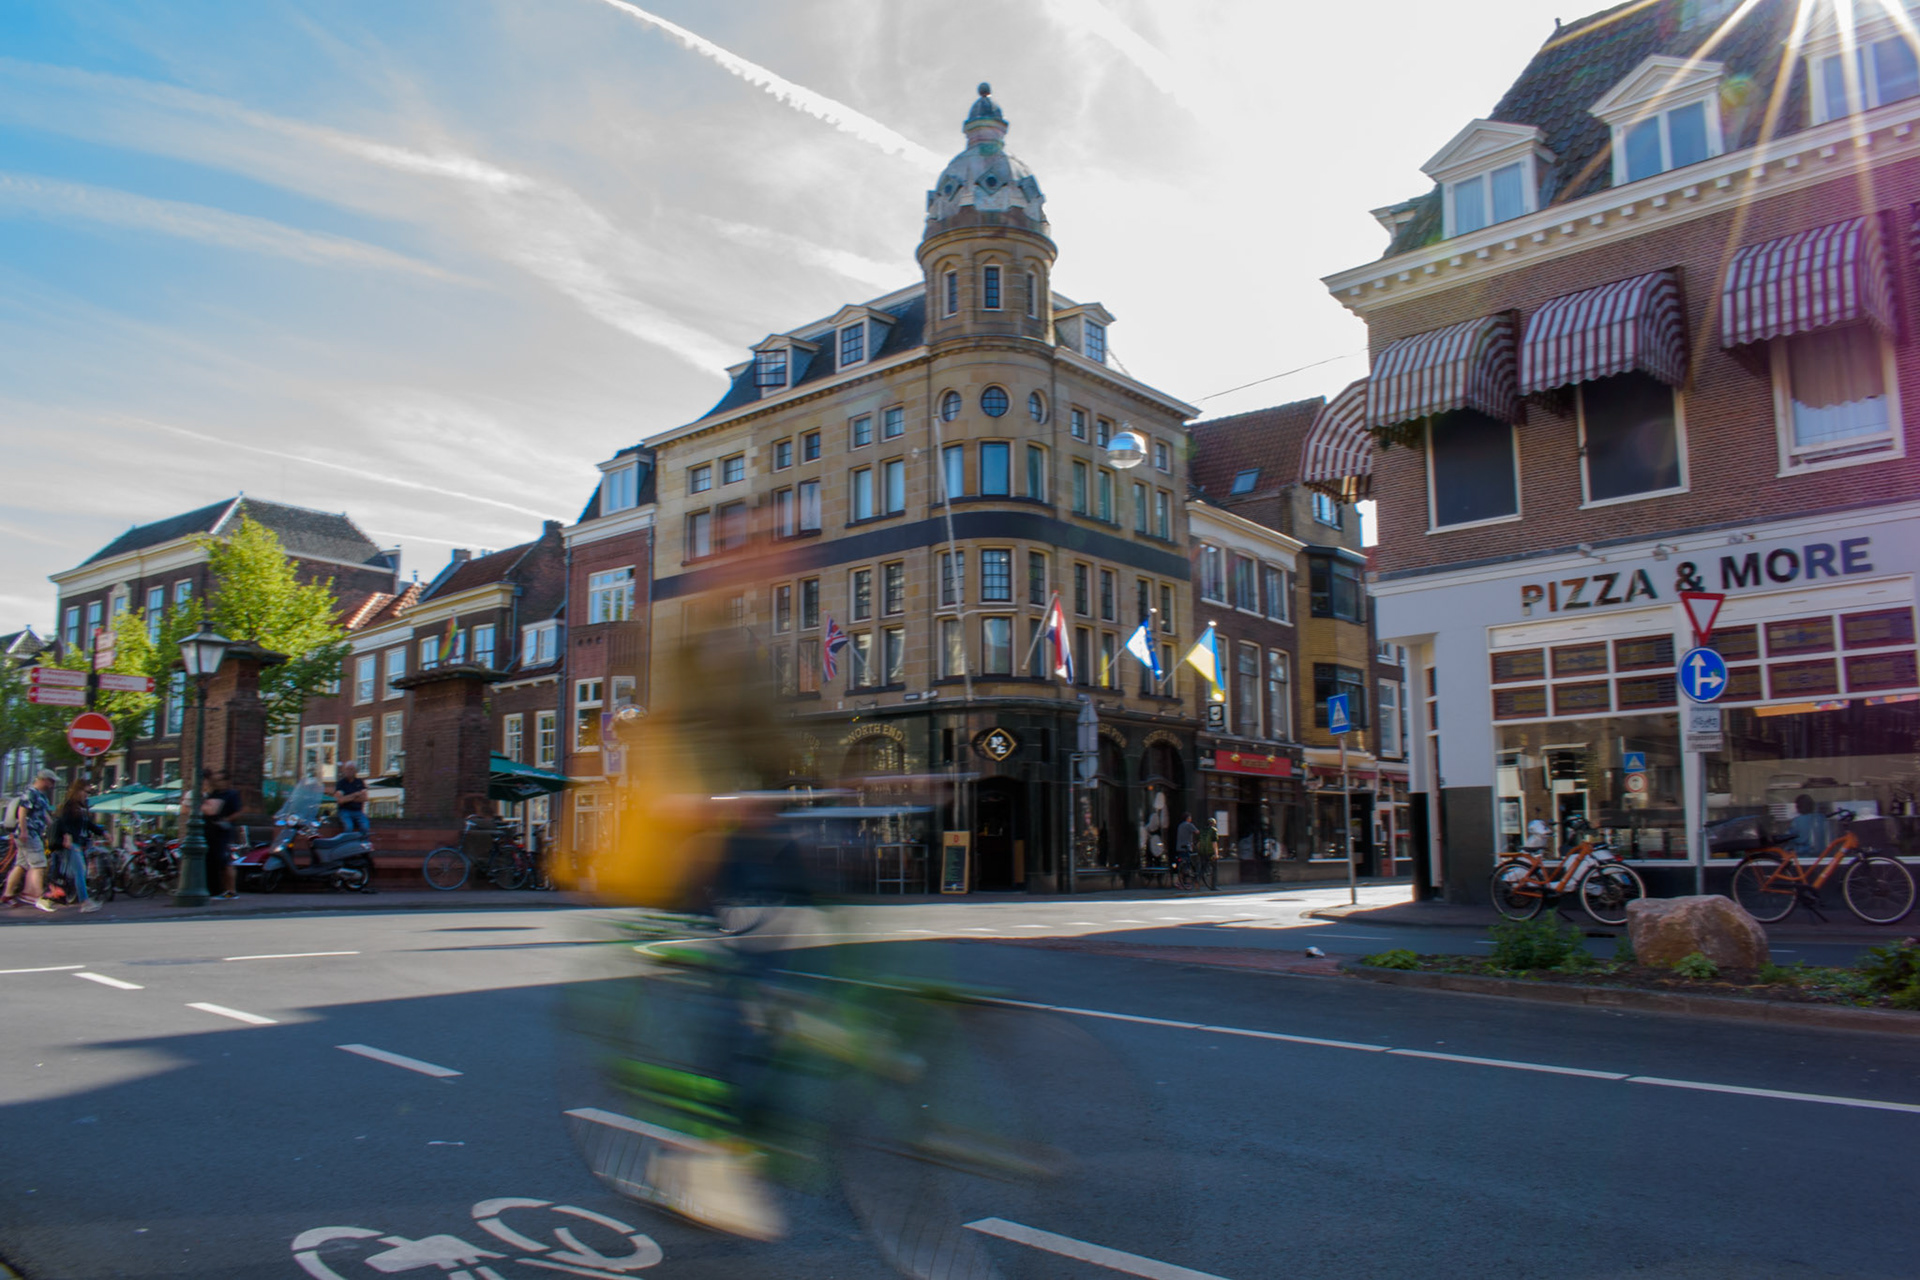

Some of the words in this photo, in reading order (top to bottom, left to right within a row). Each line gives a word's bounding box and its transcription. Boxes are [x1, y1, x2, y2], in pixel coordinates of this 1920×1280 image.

[1520, 568, 1658, 616] PIZZA
[1674, 561, 1706, 593] &
[1719, 536, 1874, 590] MORE
[847, 723, 881, 743] NORTH
[882, 724, 904, 742] END
